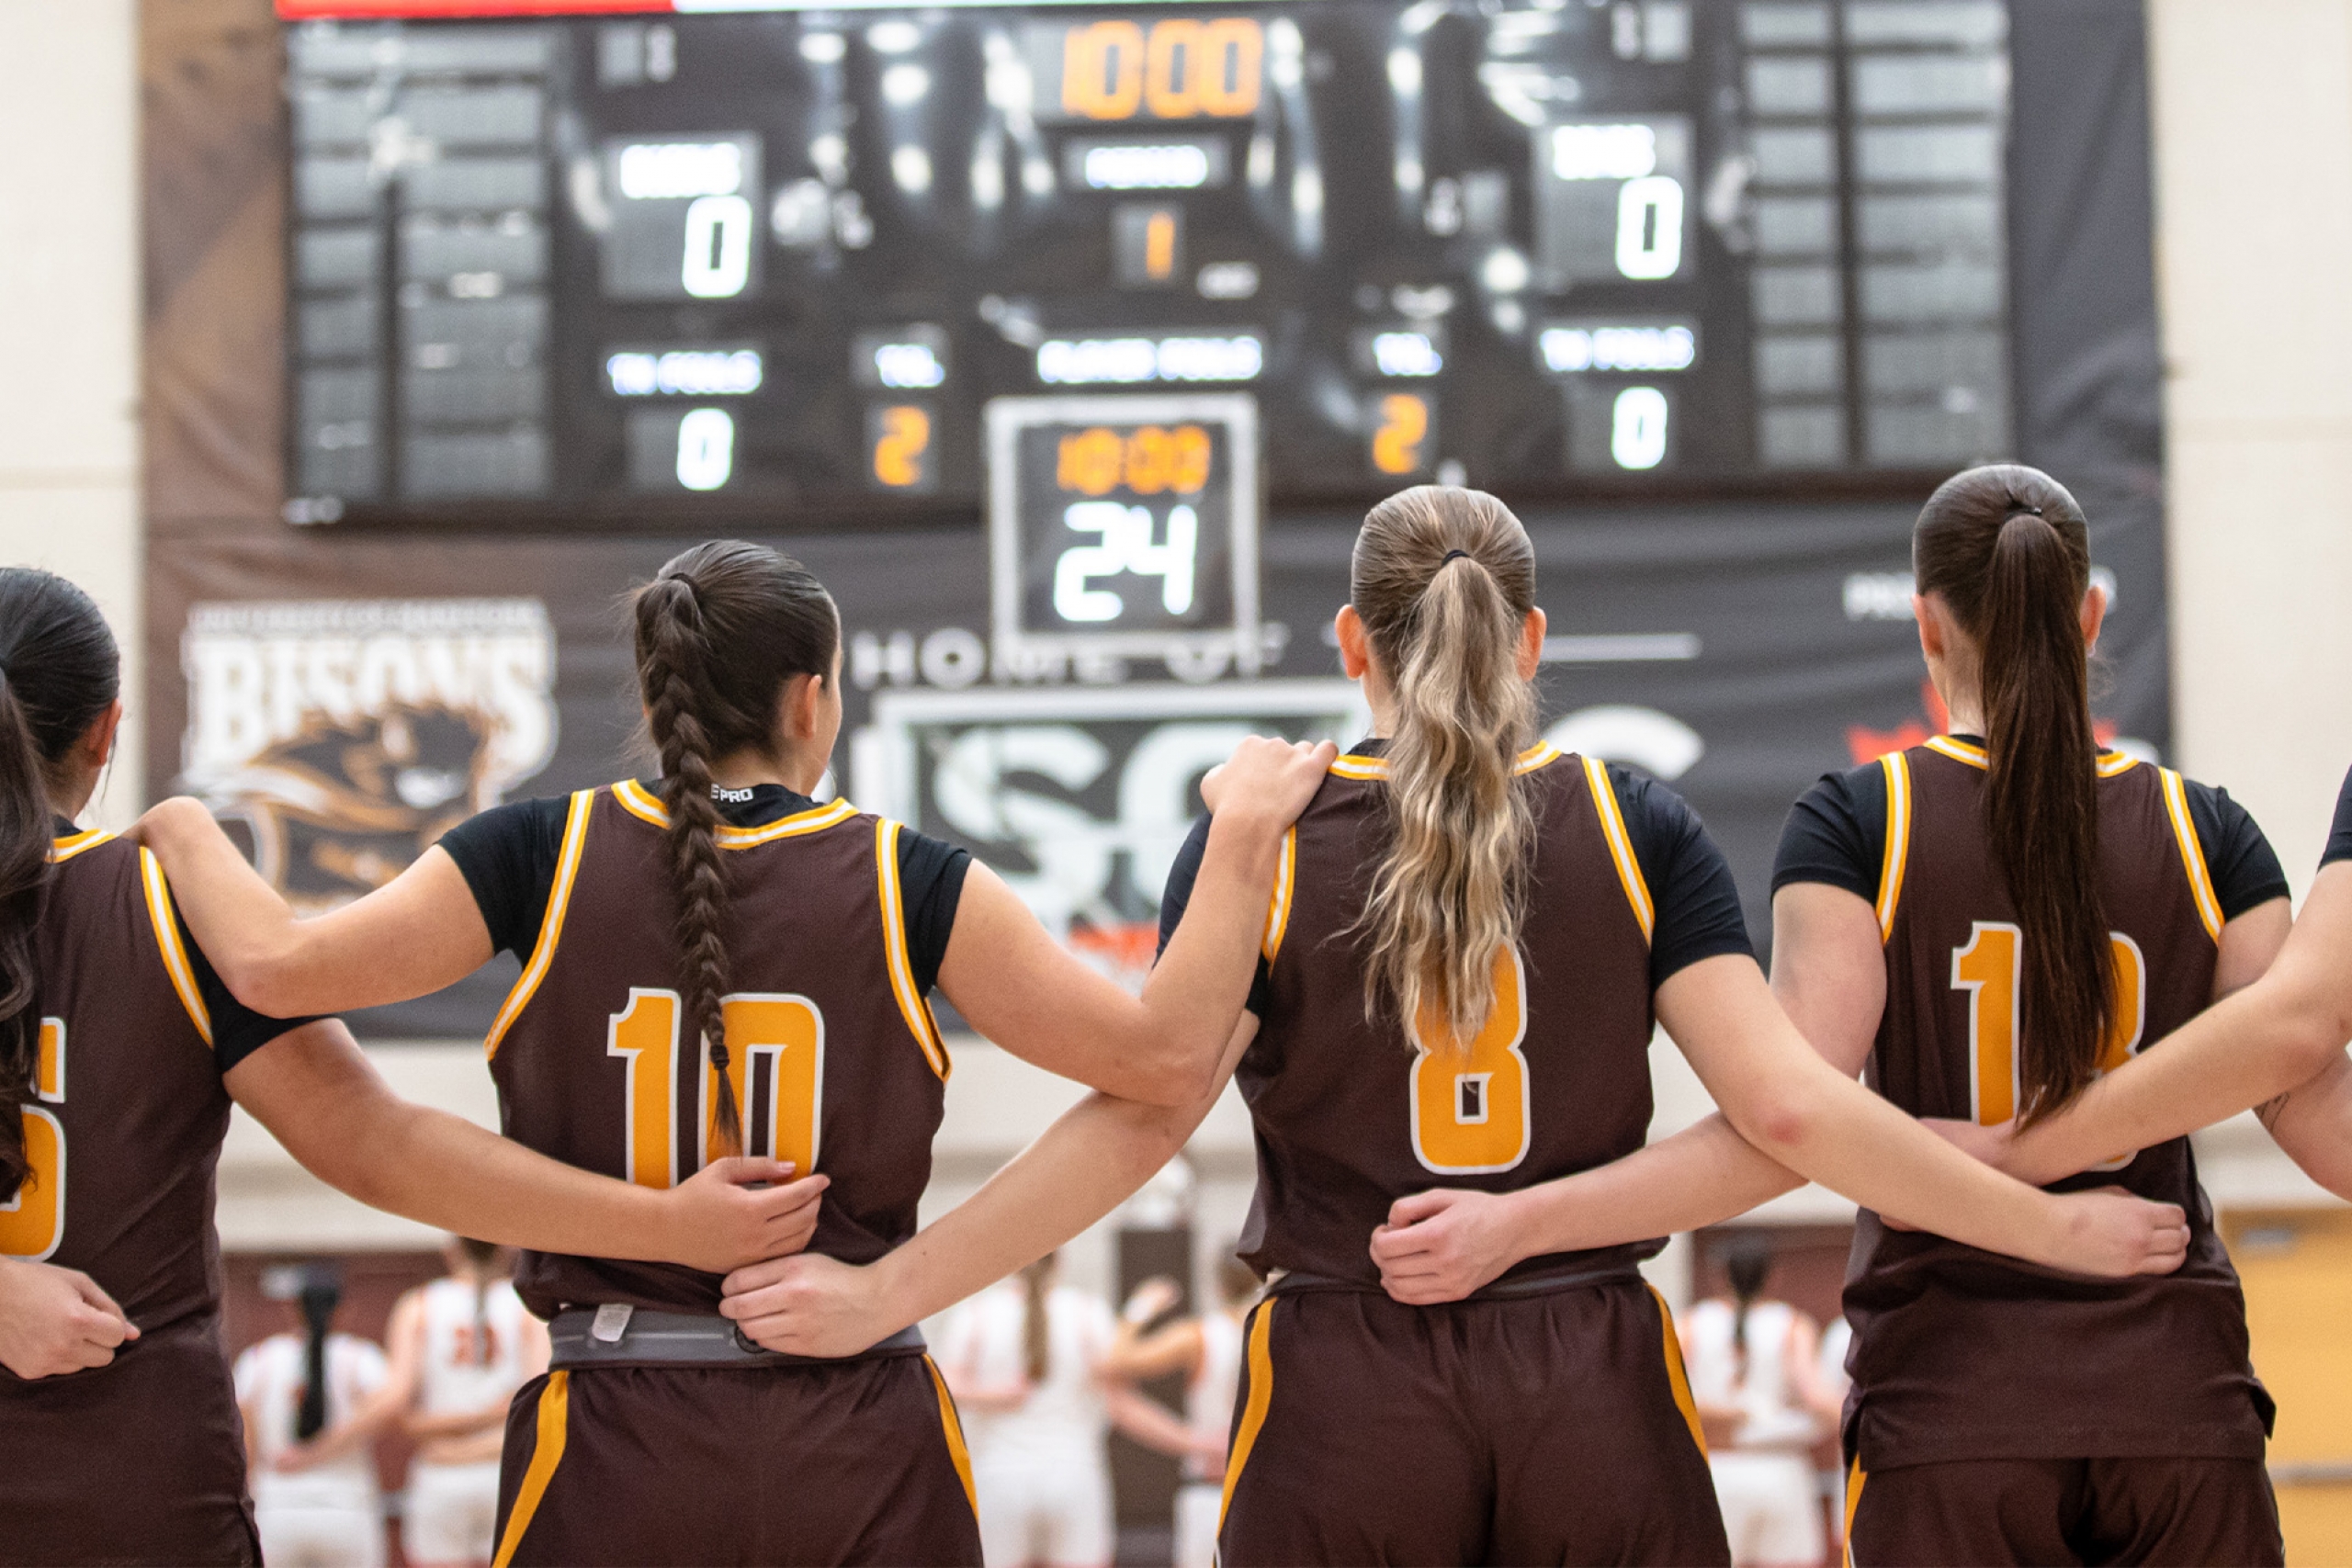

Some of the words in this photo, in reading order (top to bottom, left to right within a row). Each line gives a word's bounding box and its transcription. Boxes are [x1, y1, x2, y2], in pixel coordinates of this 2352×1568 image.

[682, 195, 752, 298] 0
[1146, 211, 1176, 279] 1
[1615, 175, 1684, 279] 0
[676, 409, 734, 491] 0
[875, 406, 929, 487] 2
[1373, 395, 1428, 474] 2
[1611, 387, 1668, 469] 0
[1054, 501, 1198, 622] 24
[188, 634, 557, 776] BISONS
[606, 986, 825, 1190] 10
[1409, 932, 1531, 1176] 8
